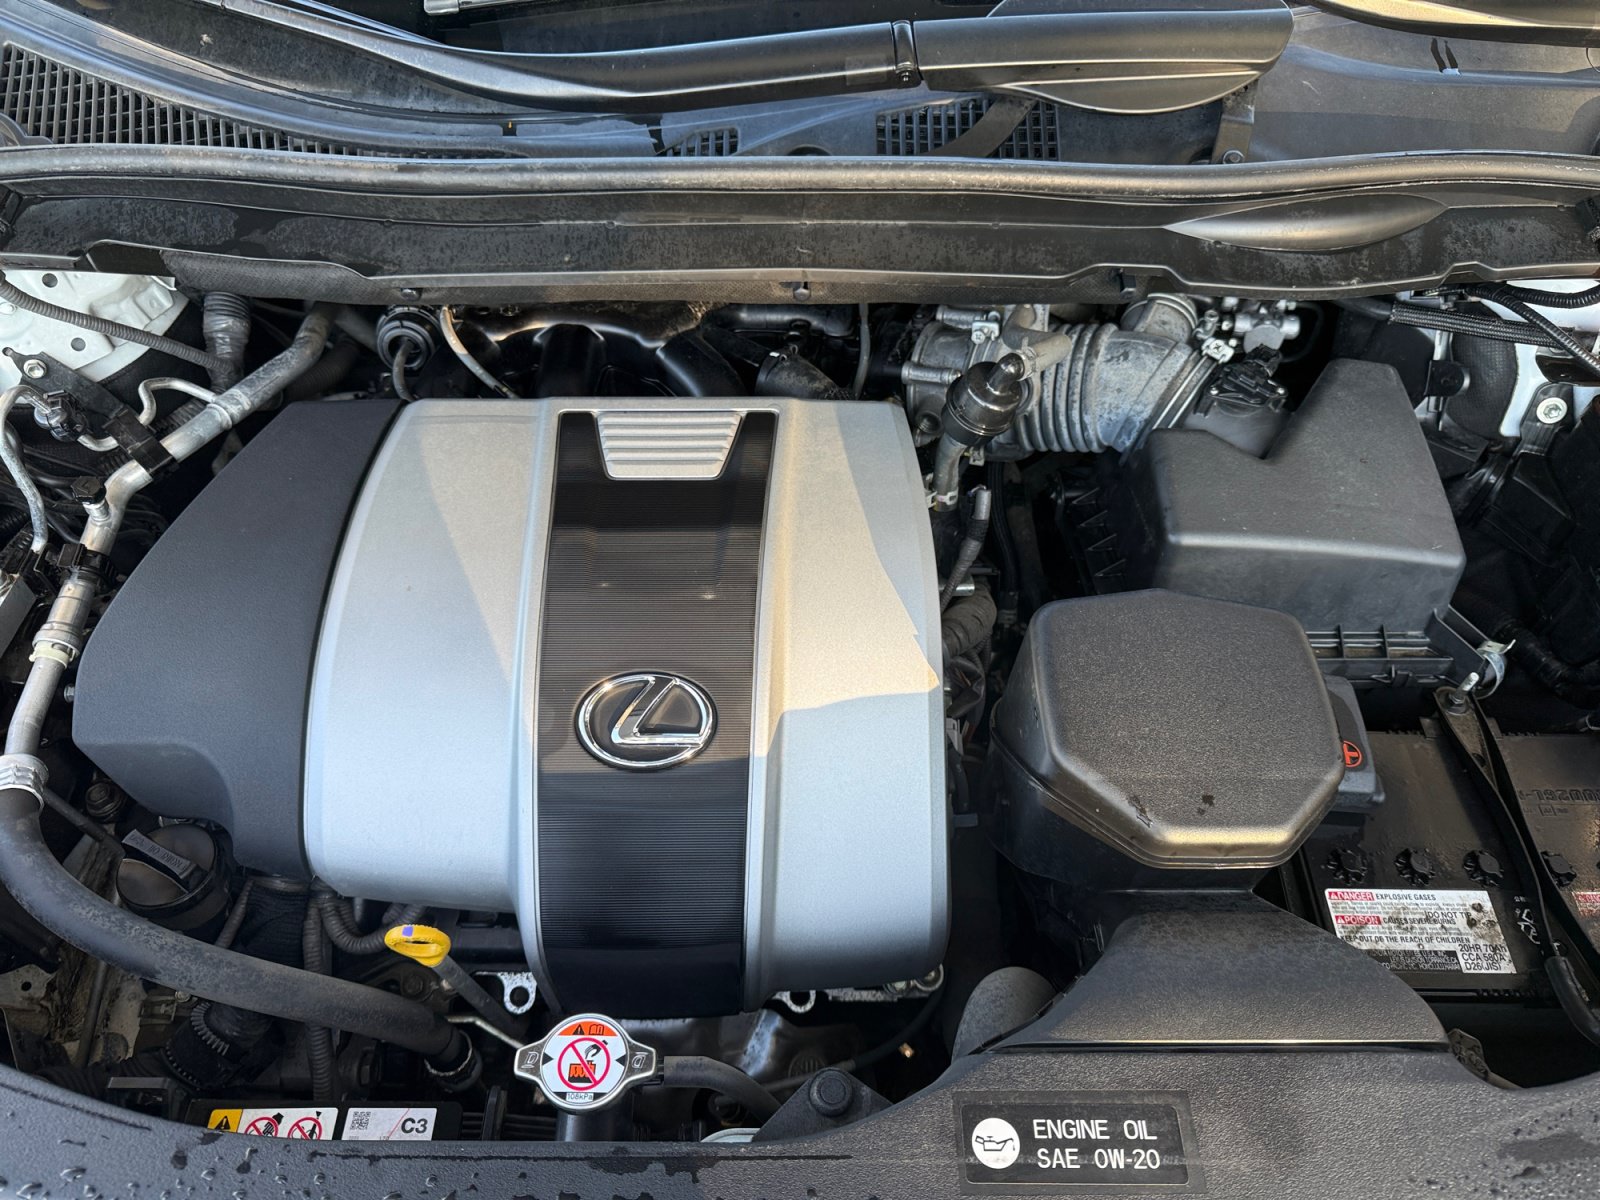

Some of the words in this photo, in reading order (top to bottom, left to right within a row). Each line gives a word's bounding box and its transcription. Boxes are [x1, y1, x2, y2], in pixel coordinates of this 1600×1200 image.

[1337, 892, 1373, 901] DANGER
[1414, 893, 1437, 901] GASES
[1345, 915, 1378, 925] POISON
[1436, 936, 1471, 944] CHILDREN
[1459, 944, 1483, 953] 20HR
[1484, 944, 1507, 953] 70Ah
[1462, 953, 1481, 961] CCA
[1483, 953, 1506, 962] 580A
[1465, 962, 1502, 971] D26(JIS)
[567, 1093, 593, 1101] 108kPa
[400, 1117, 428, 1134] C3
[1032, 1119, 1110, 1140] ENGINE
[1123, 1119, 1158, 1141] OIL
[1037, 1148, 1081, 1169] SAE
[1093, 1148, 1161, 1170] 0W-20
